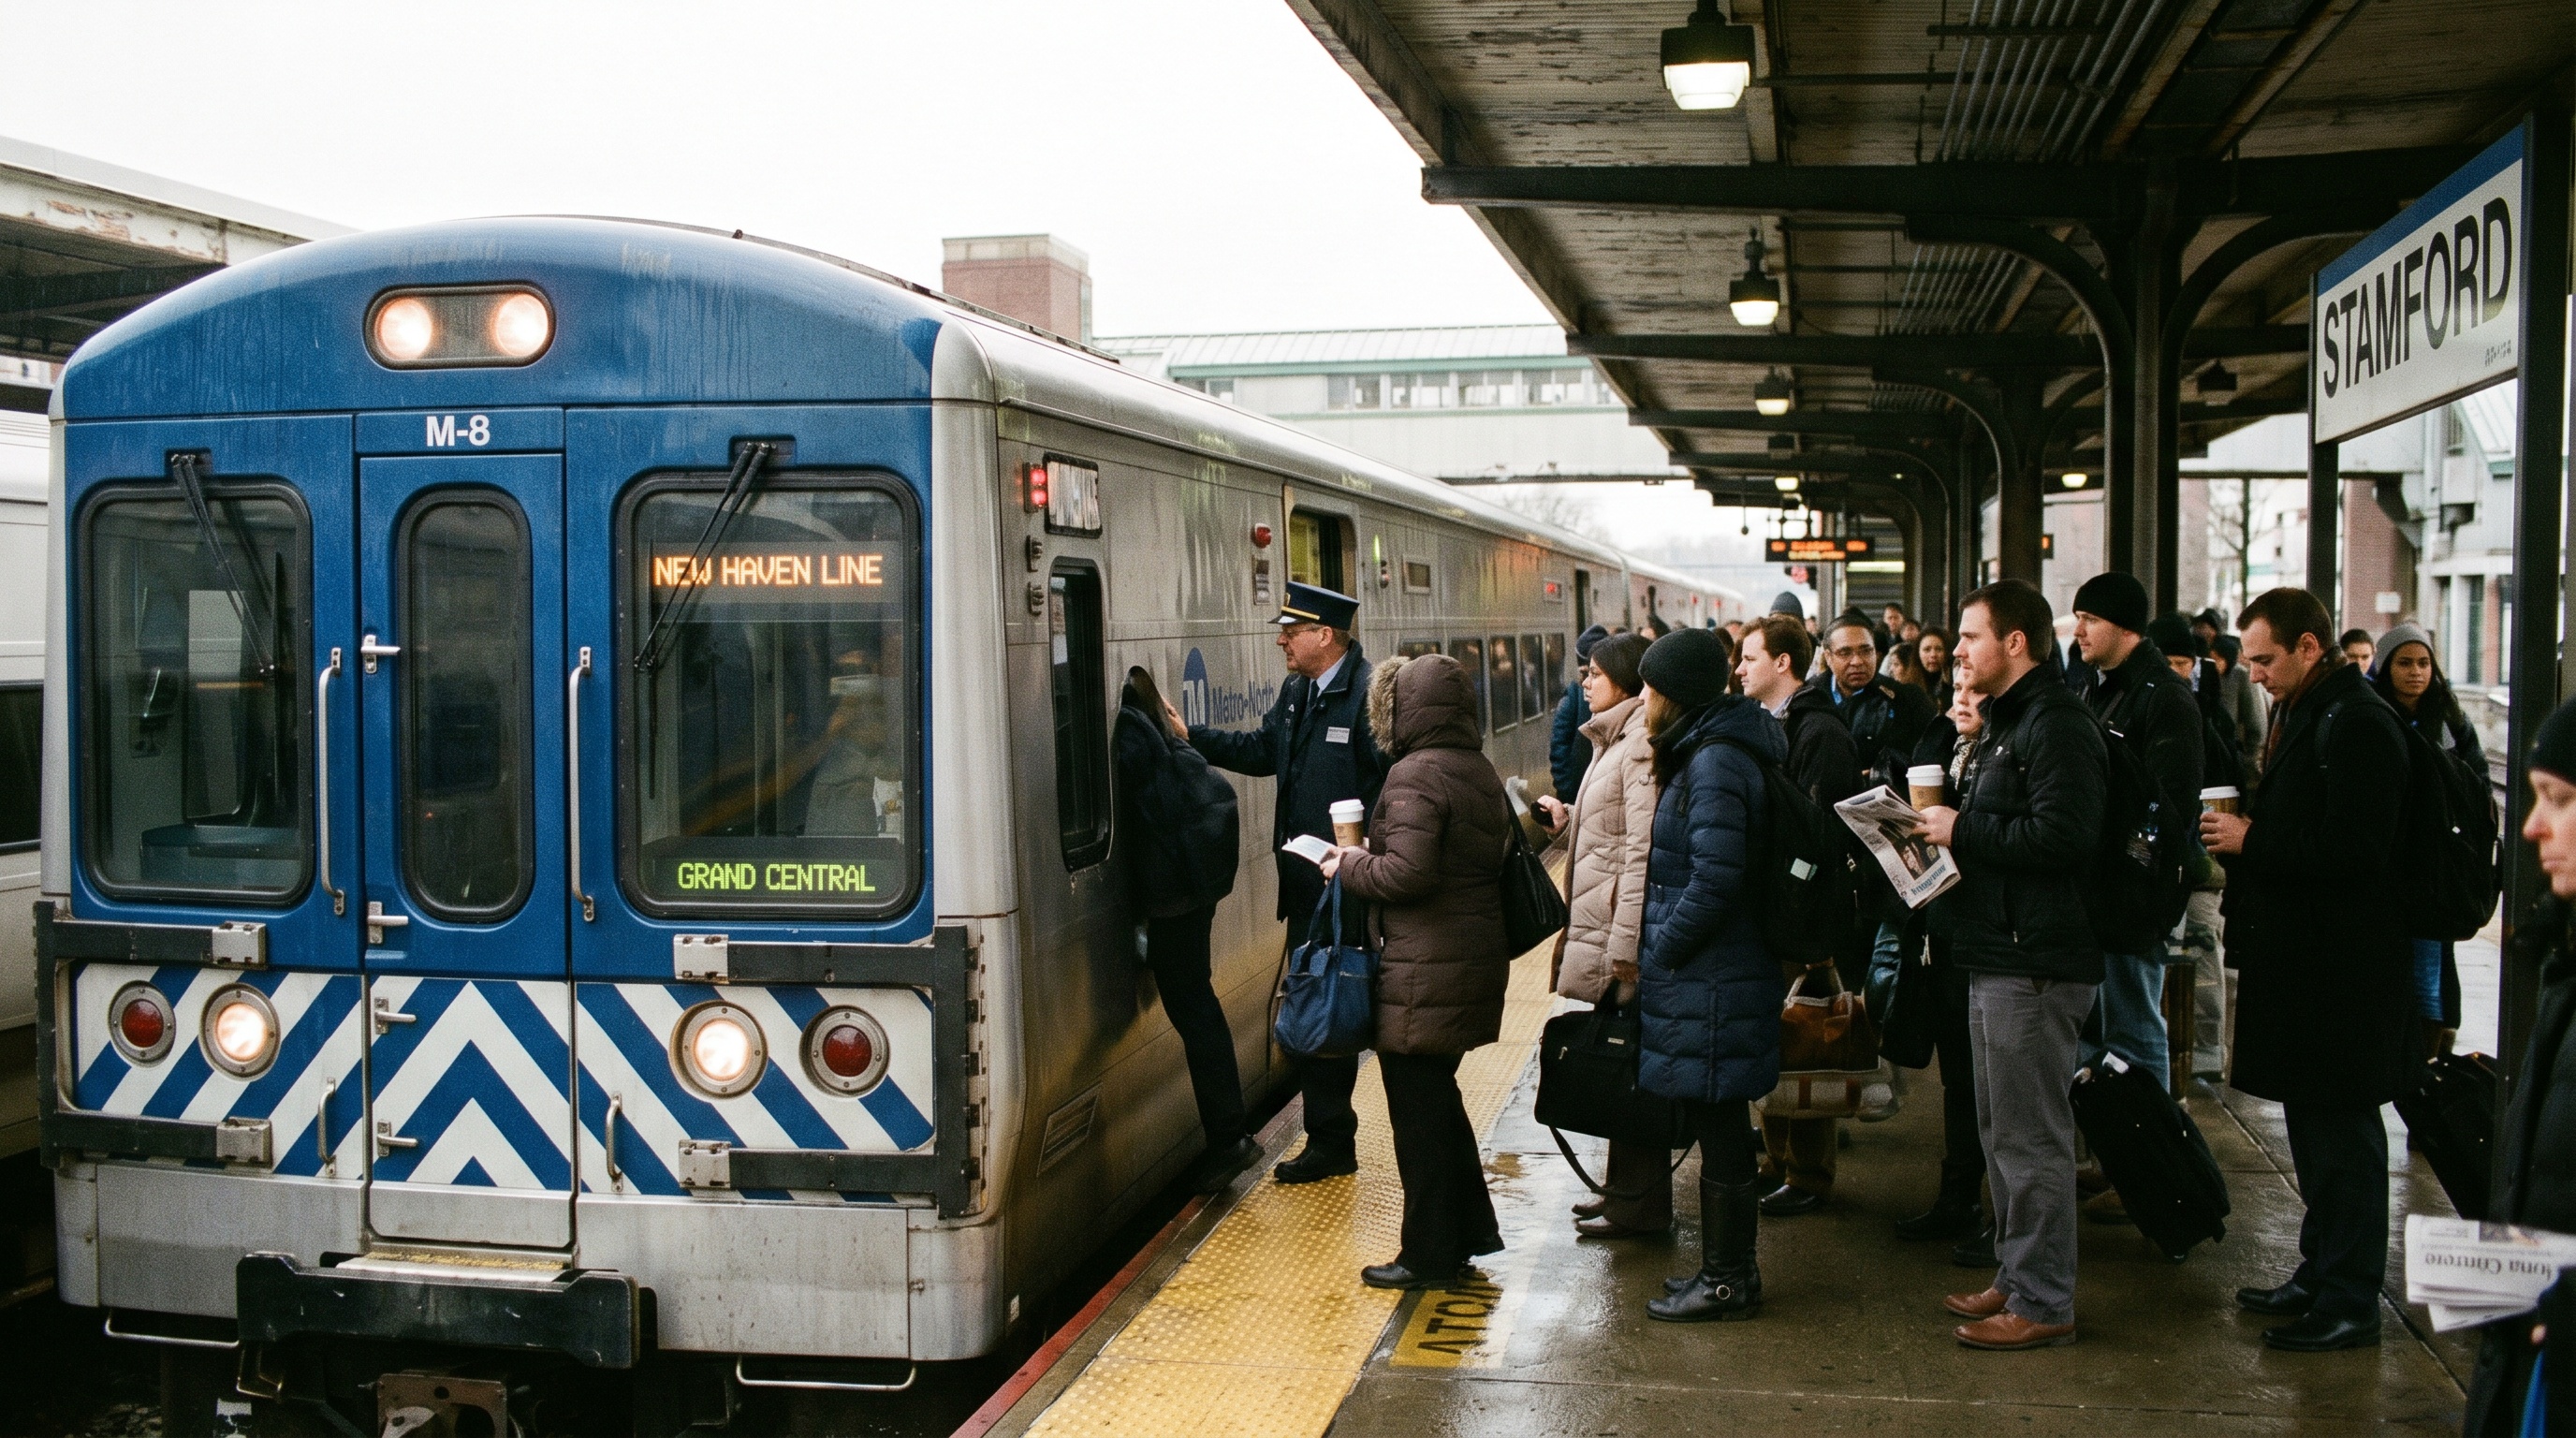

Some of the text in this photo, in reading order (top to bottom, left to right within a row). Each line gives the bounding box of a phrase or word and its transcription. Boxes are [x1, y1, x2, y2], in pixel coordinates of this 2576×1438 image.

[2322, 196, 2513, 400] STAMFORD
[427, 415, 491, 448] M-8
[654, 555, 884, 587] NEW HAVEN LINE
[678, 862, 876, 893] GRAND CENTRAL
